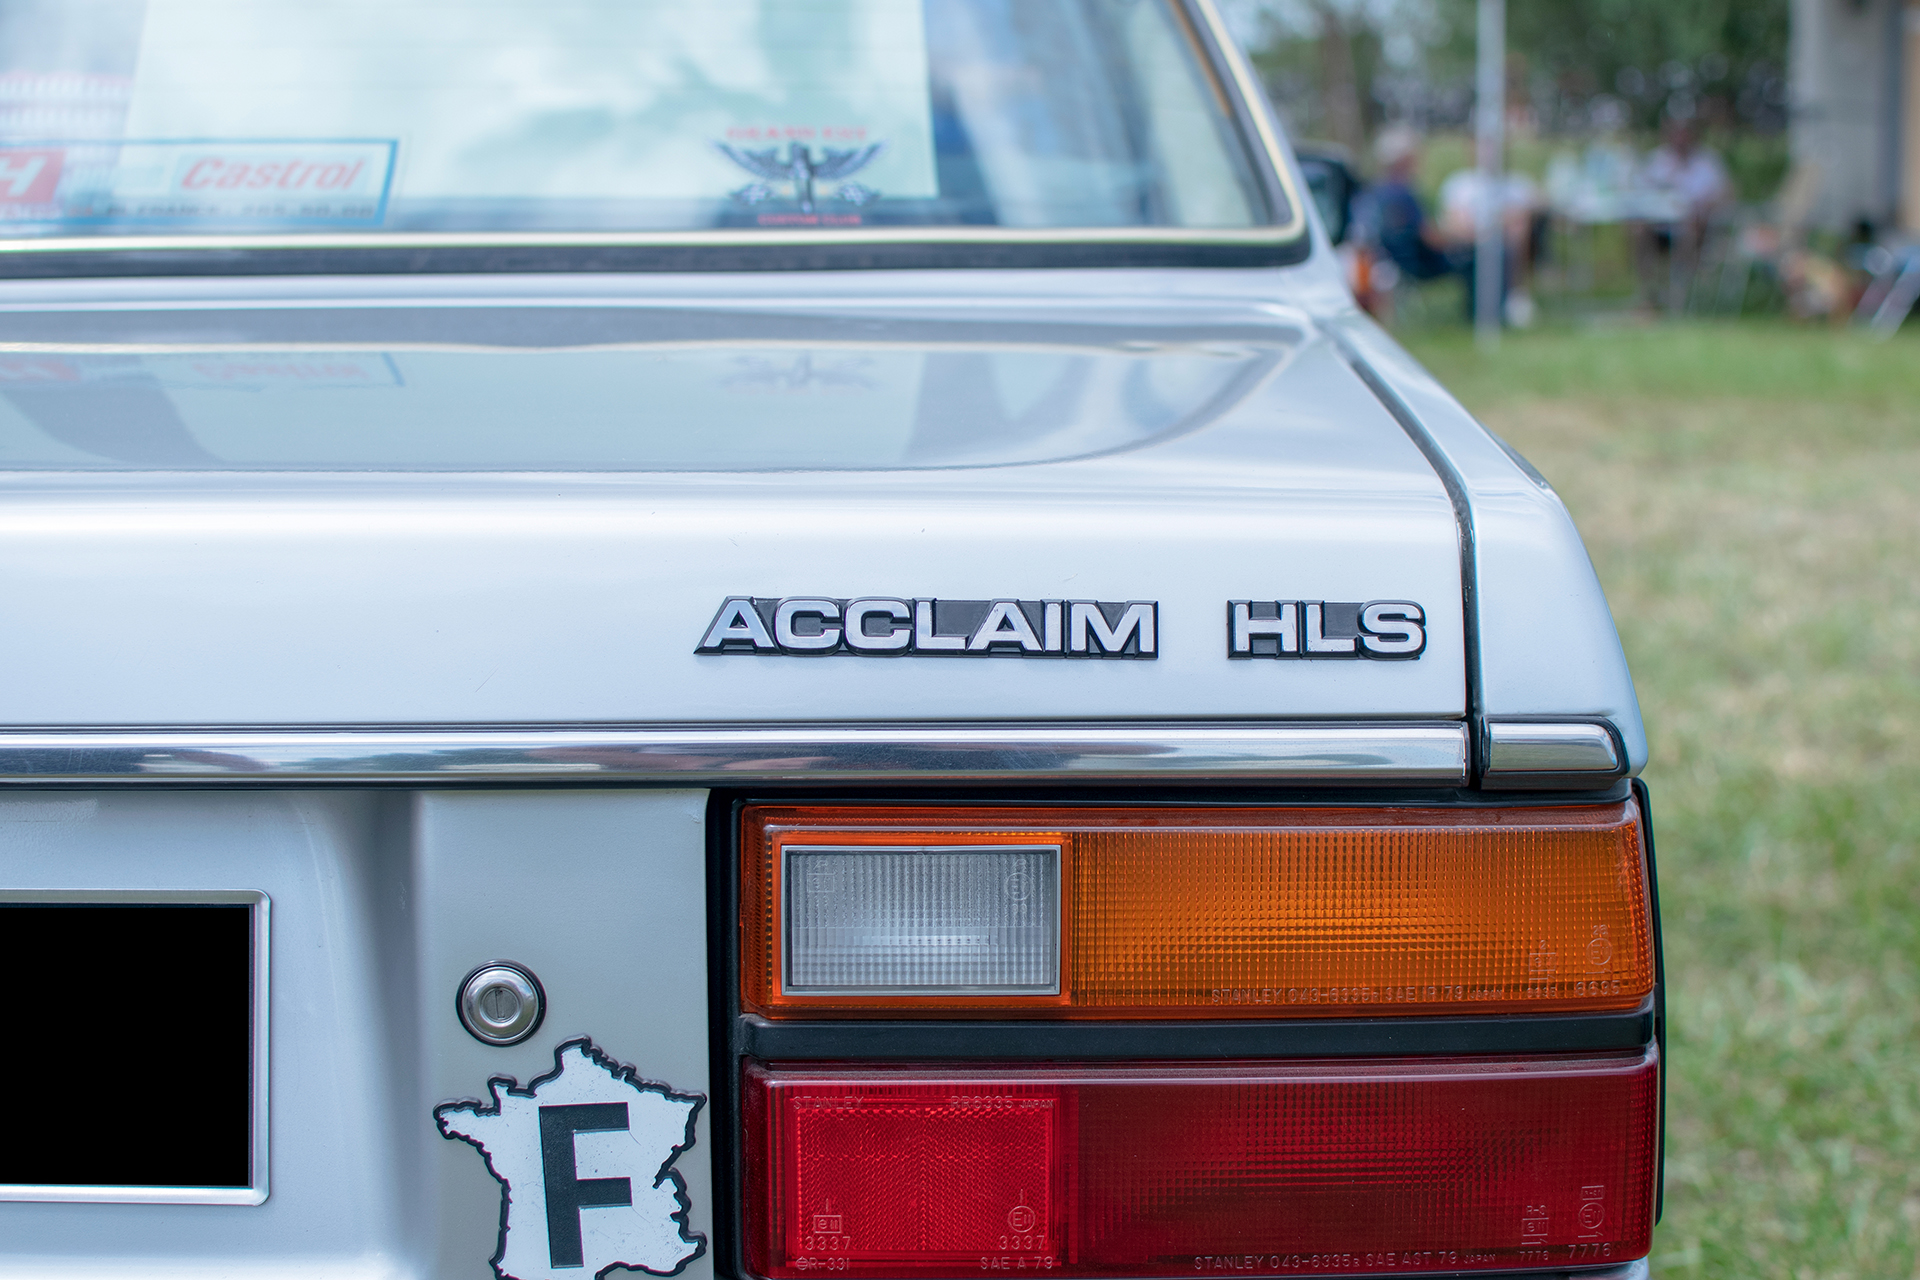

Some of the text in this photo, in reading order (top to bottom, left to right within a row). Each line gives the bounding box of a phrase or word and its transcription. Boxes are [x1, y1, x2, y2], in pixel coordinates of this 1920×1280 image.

[181, 157, 366, 190] Castrol
[696, 597, 1426, 660] ACCLAIM HLS
[1212, 988, 1282, 1003] STANLEY
[793, 1096, 864, 1110] STANLEY
[538, 1102, 633, 1269] F
[805, 1236, 850, 1251] 3337
[999, 1235, 1045, 1250] 3337
[1194, 1256, 1264, 1270] STANLEY
[1366, 1253, 1396, 1267] SAE
[1402, 1252, 1432, 1266] AST
[1438, 1251, 1457, 1265] 79
[1463, 1254, 1496, 1264] JAPAN
[1520, 1243, 1611, 1262] 7776 7776
[980, 1256, 1053, 1270] SAE A 79
